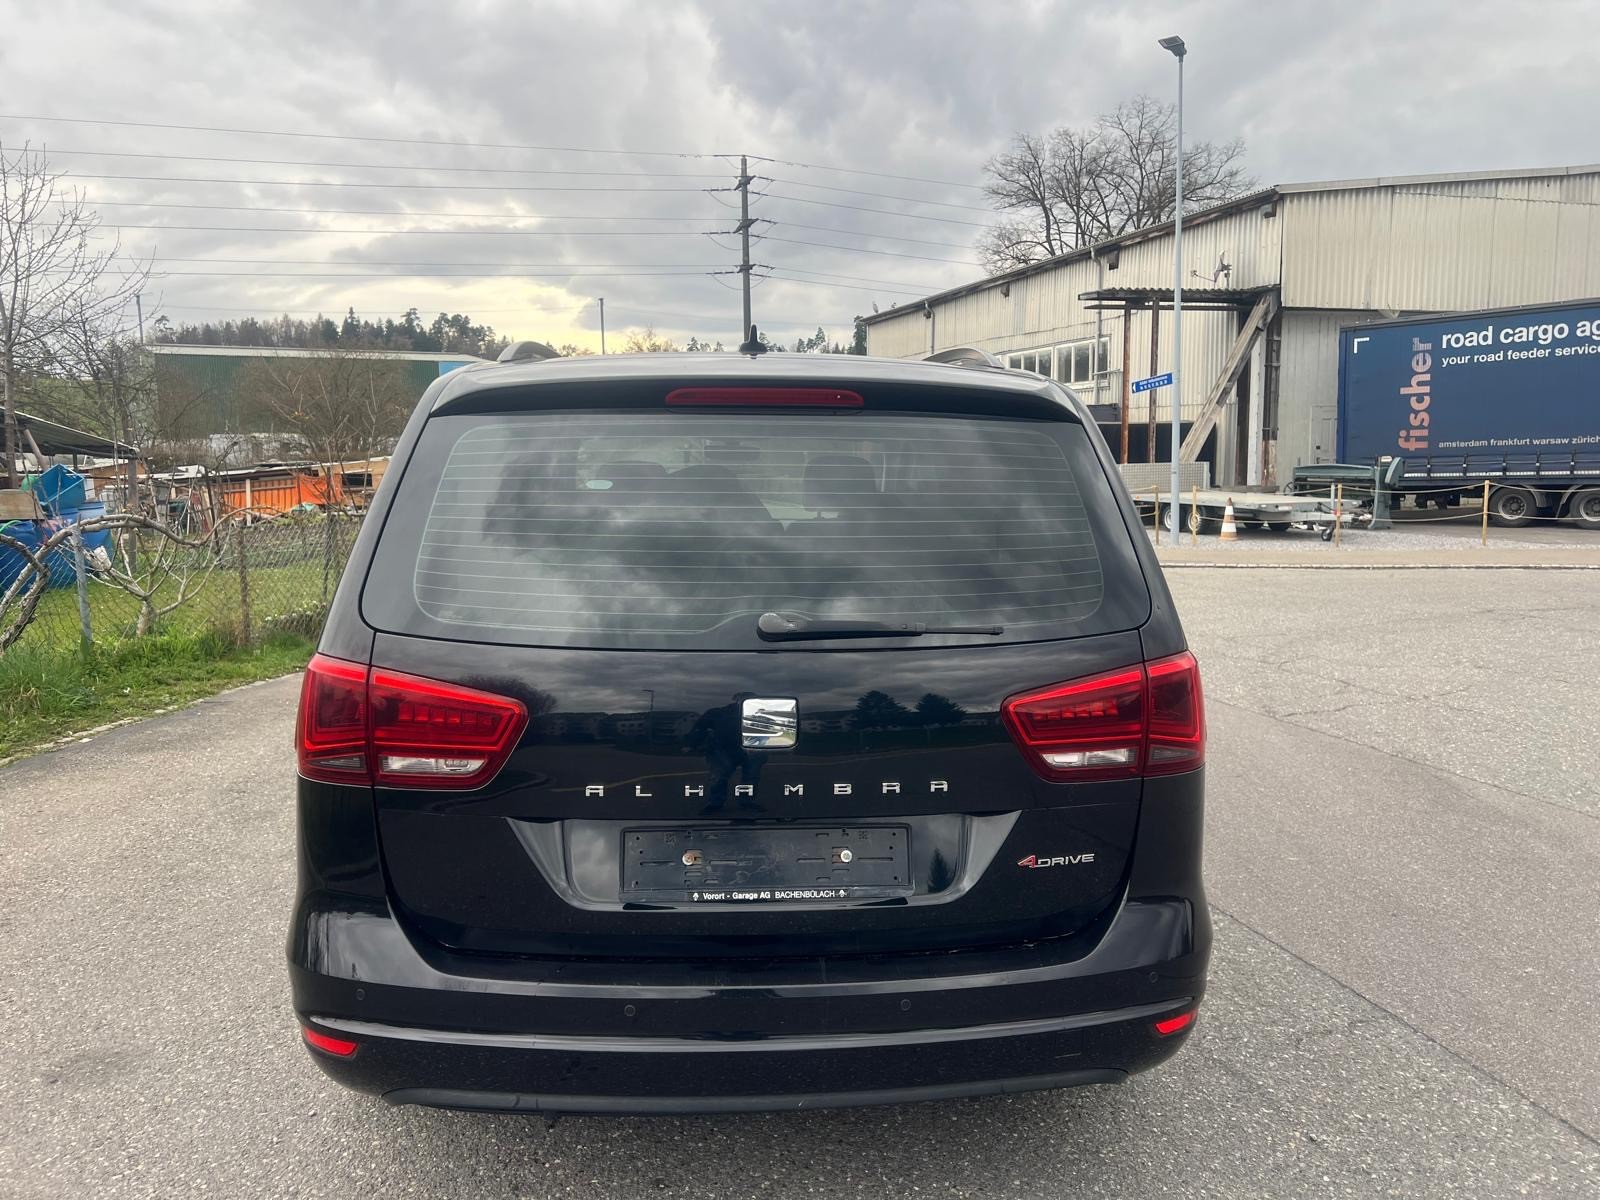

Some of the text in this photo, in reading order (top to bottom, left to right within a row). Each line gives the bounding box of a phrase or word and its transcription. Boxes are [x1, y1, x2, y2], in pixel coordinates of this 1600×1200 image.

[1441, 325, 1493, 349] road
[1499, 322, 1569, 345] cargo
[1441, 343, 1600, 368] your road feeder servic
[1398, 336, 1433, 452] fischer
[1438, 439, 1488, 448] amsterdam
[1490, 438, 1530, 447] frankfurt
[1533, 437, 1570, 445] warsaw
[585, 780, 948, 797] ALHAMBRA
[1017, 853, 1095, 869] 4DRIVE
[702, 892, 725, 900] Vorort
[732, 891, 758, 901] Garage
[759, 891, 771, 899] AG
